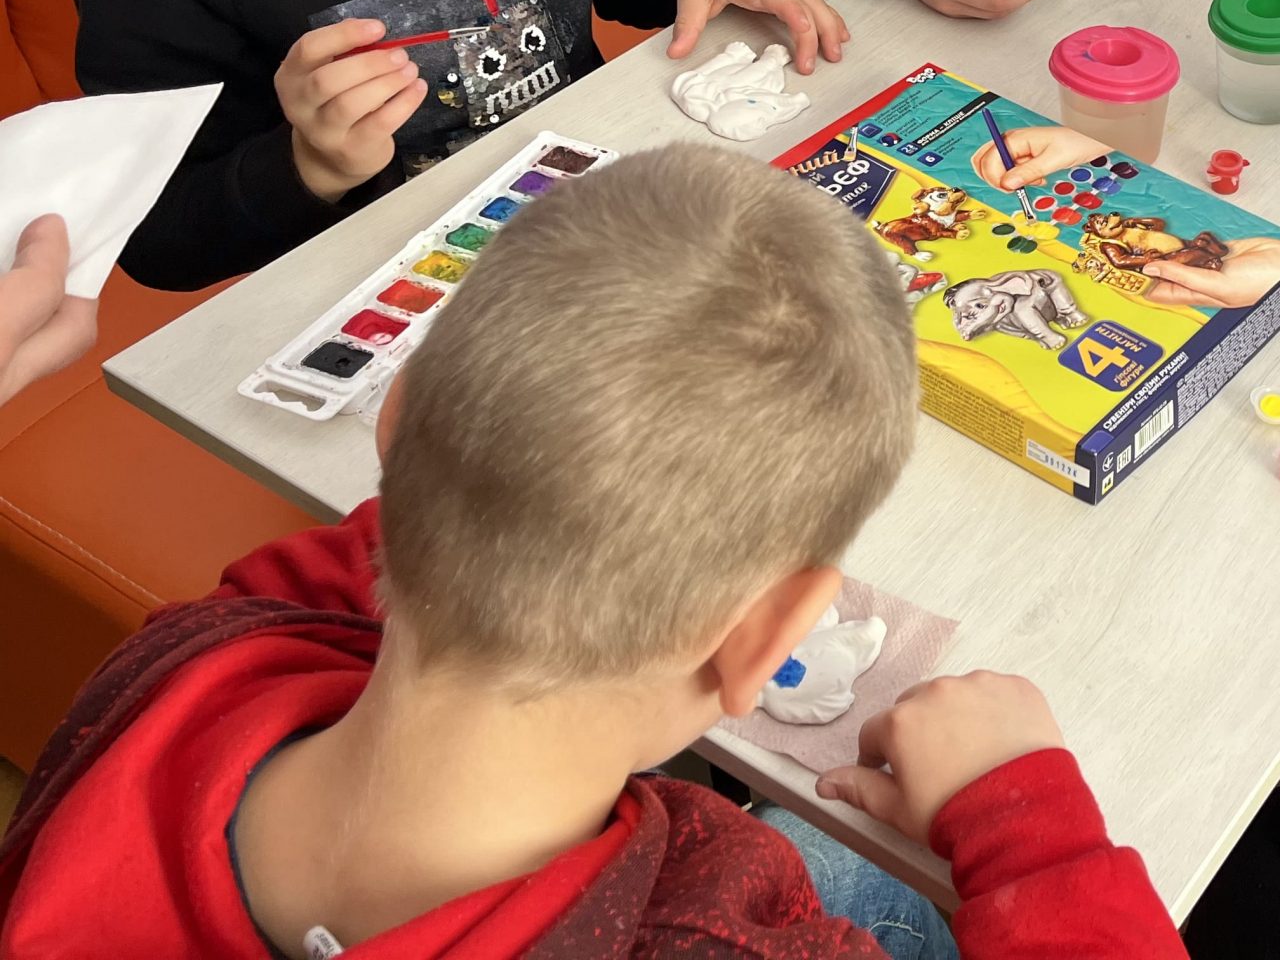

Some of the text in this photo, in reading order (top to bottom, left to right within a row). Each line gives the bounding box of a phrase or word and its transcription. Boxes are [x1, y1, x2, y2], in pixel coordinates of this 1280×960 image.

[925, 155, 936, 163] 6
[1095, 326, 1142, 353] МАГНІТИ
[1077, 336, 1131, 378] 4
[1102, 398, 1136, 430] СУВЕНІРИ
[1134, 373, 1161, 401] СВОЇМИ
